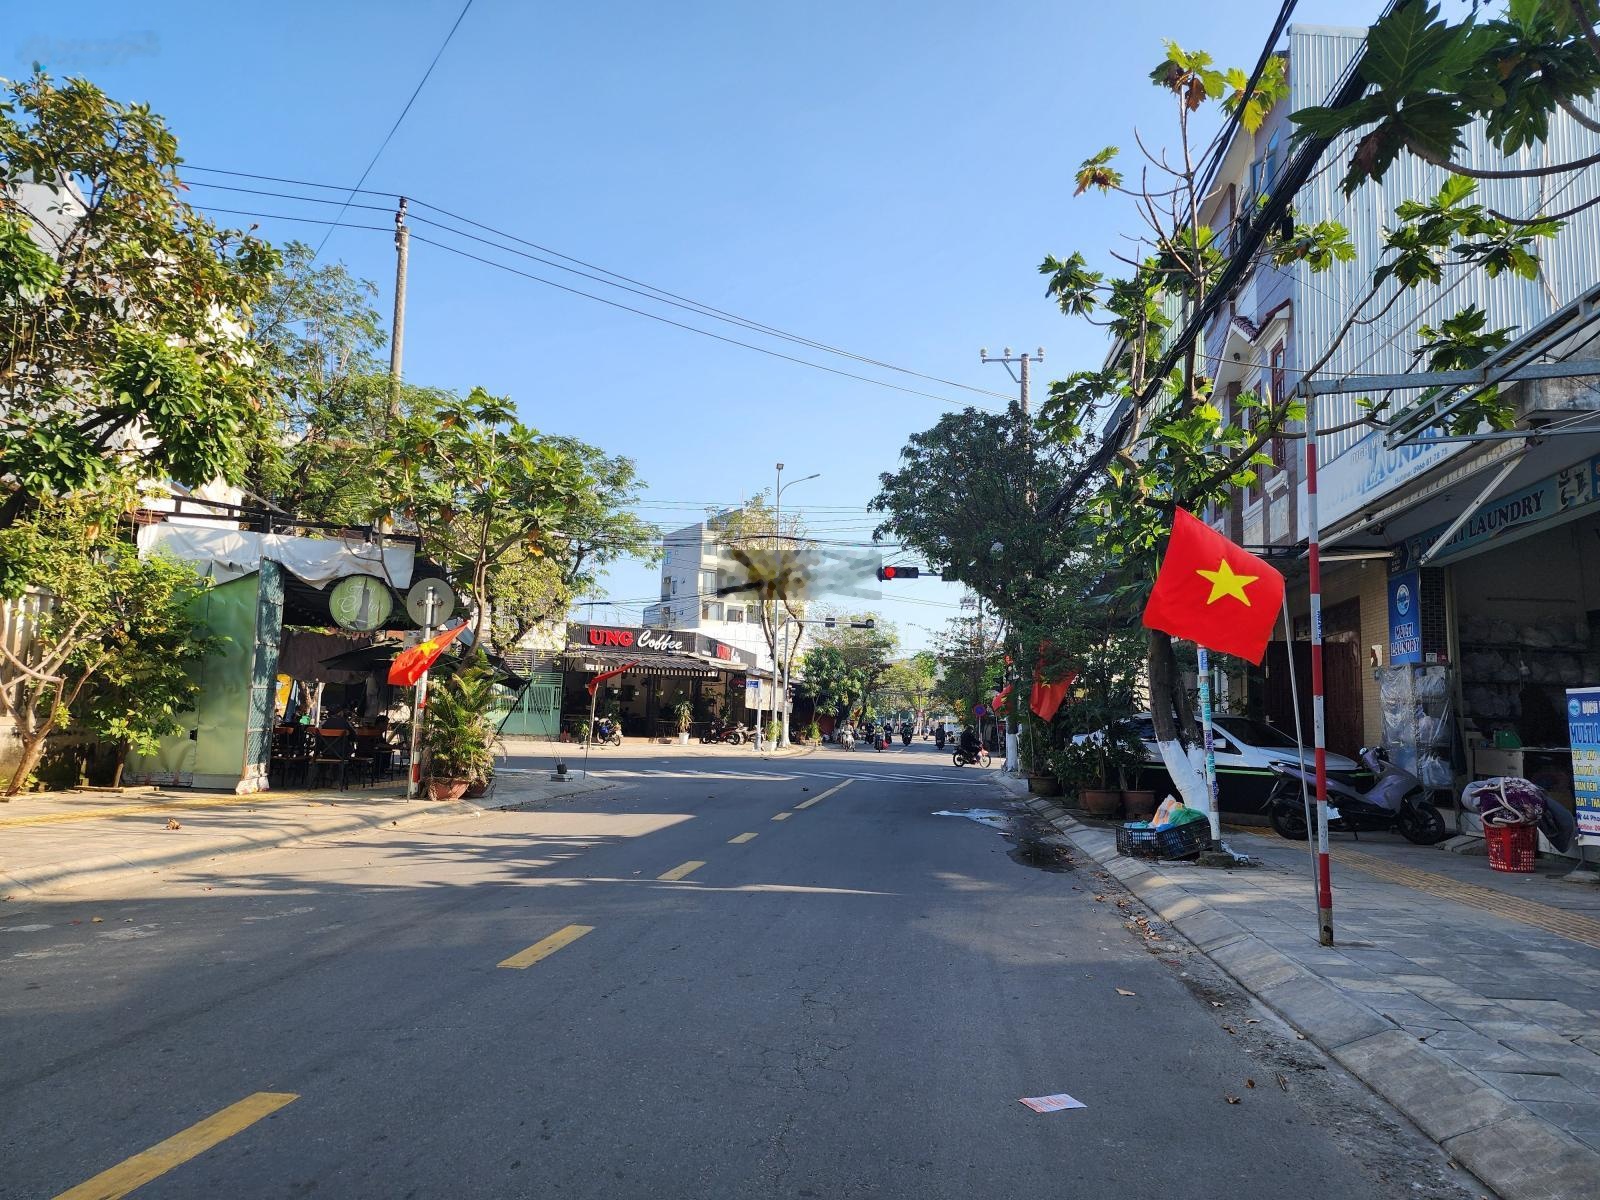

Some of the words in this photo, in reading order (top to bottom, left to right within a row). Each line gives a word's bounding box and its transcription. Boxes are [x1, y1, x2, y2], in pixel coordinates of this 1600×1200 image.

[1469, 489, 1545, 538] LAUNDRY
[589, 629, 634, 647] UNG
[637, 629, 683, 650] Coffee
[1395, 622, 1414, 640] MULTI
[1391, 637, 1419, 657] LAUNDRY
